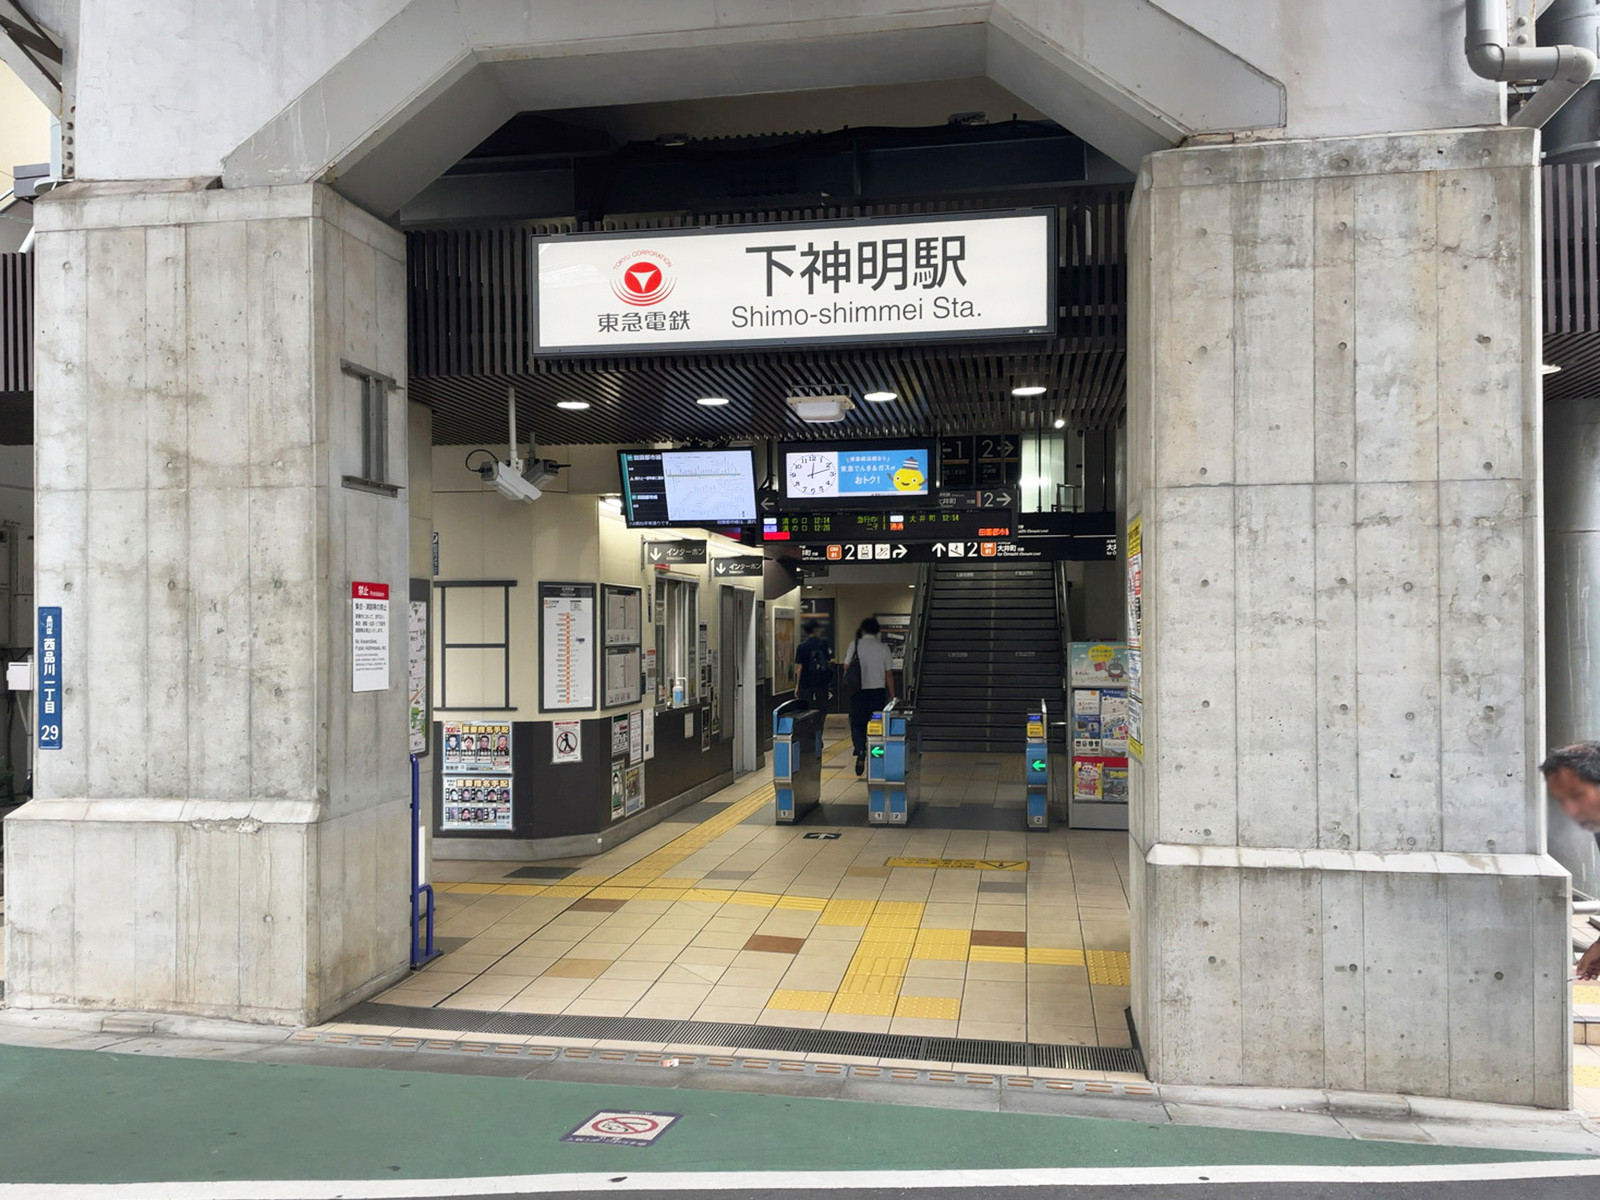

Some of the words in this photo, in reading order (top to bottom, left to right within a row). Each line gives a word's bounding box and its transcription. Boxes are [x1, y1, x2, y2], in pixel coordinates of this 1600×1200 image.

[632, 249, 672, 268] CORPORATION
[745, 235, 967, 297] 下神明駅
[732, 297, 923, 329] Shimo-shimmei
[932, 296, 983, 319] Sta.
[597, 310, 690, 333] 東急電鉄
[982, 439, 994, 458] 2
[854, 475, 881, 485] おトク!
[984, 492, 994, 507] 2
[666, 547, 705, 556] インターホン
[845, 545, 855, 560] 2
[967, 542, 978, 557] 2
[729, 562, 762, 570] インターホン
[811, 600, 816, 613] 1
[43, 638, 56, 714] 西品川一丁目
[41, 724, 59, 741] 29
